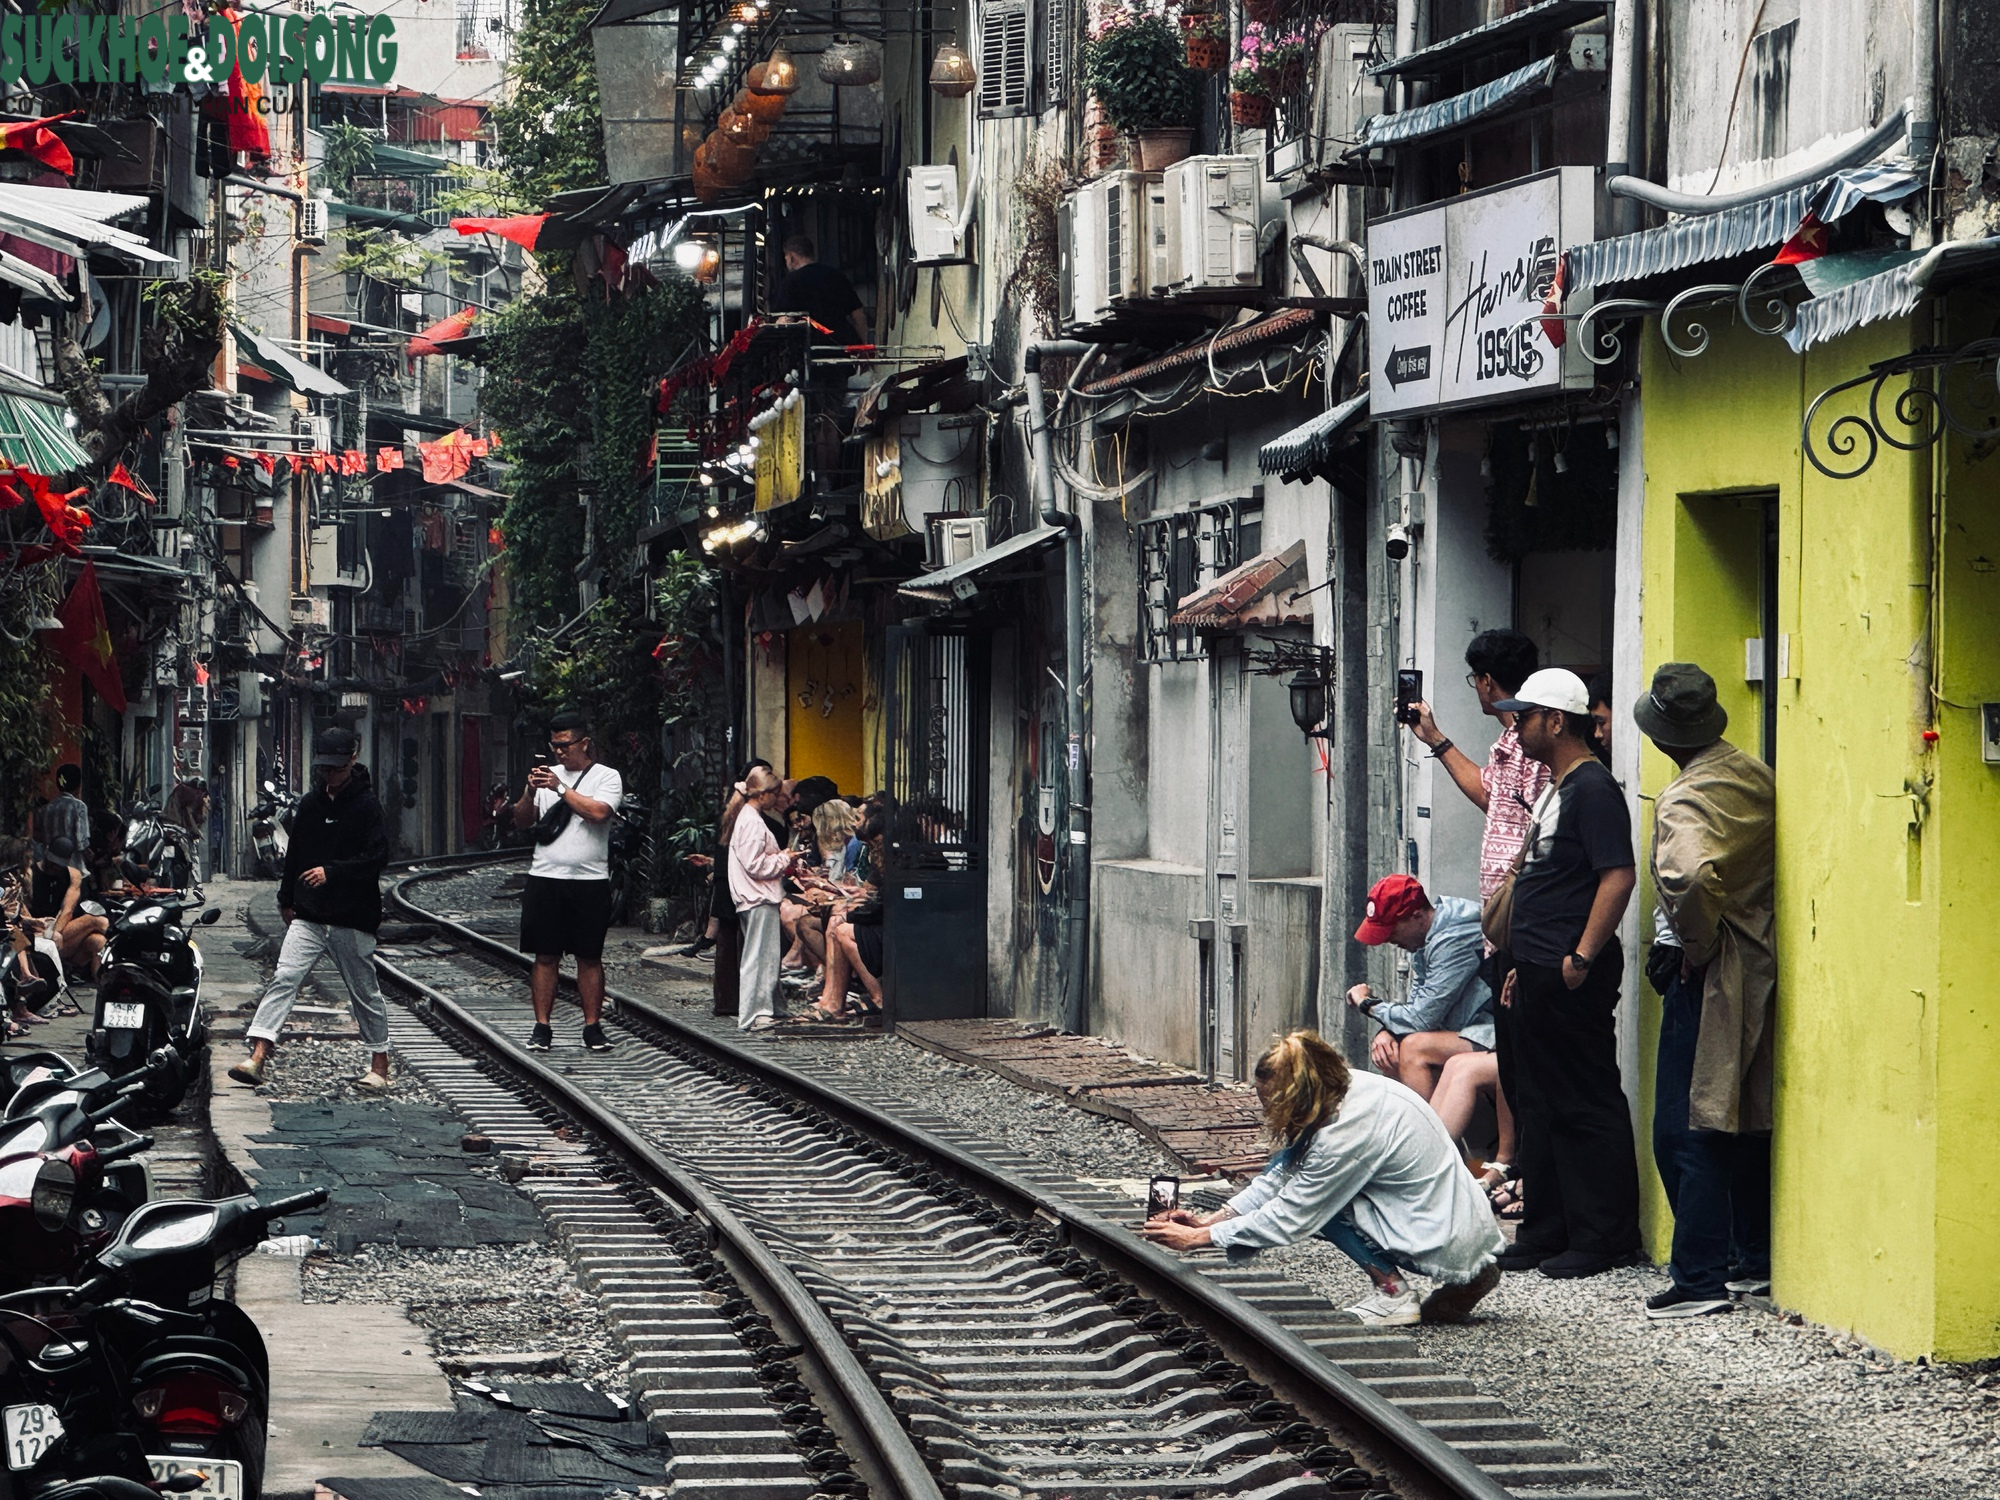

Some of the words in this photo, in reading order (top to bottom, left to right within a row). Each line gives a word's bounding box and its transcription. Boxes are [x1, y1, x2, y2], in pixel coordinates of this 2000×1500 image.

[1372, 254, 1402, 287] TRAIN
[1403, 245, 1442, 280] STREET
[1387, 289, 1427, 323] COFFEE
